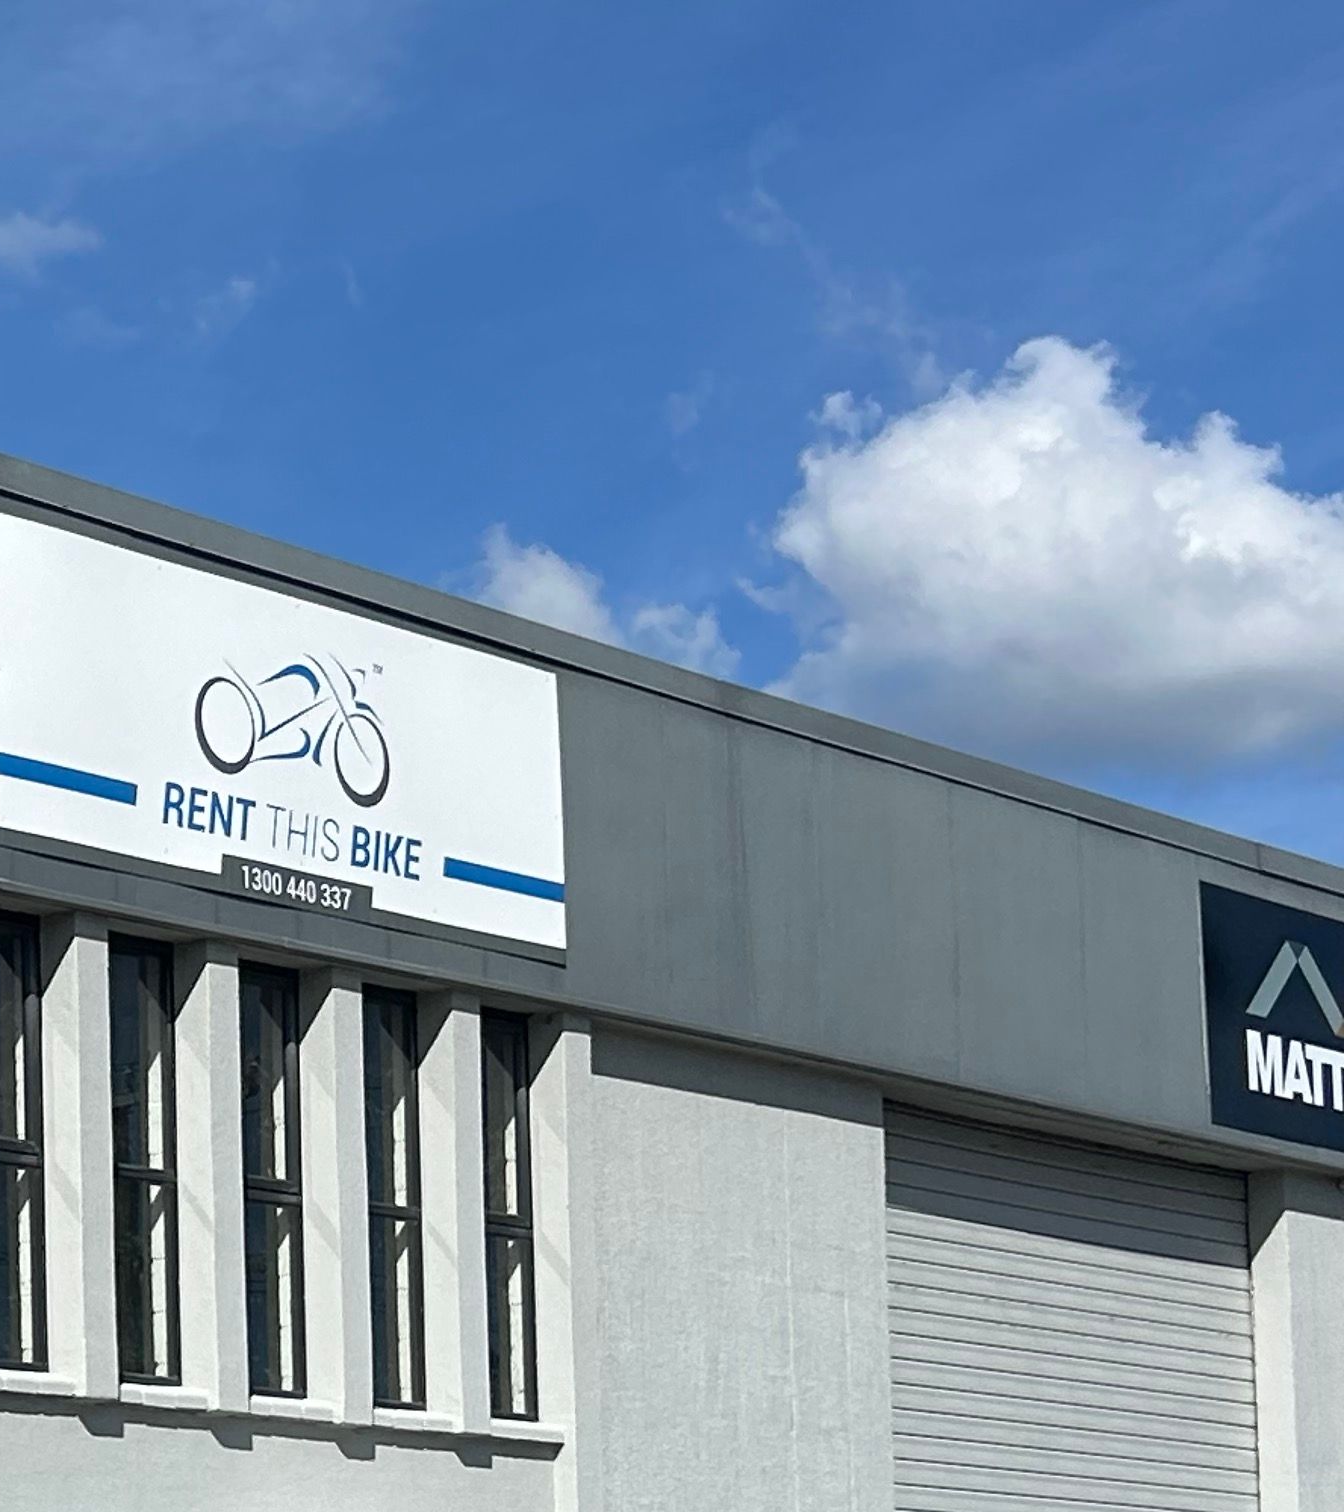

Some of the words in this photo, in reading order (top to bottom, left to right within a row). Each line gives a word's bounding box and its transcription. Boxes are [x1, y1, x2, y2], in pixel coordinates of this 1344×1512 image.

[162, 781, 256, 841] RENT
[266, 803, 340, 862] THIS
[350, 824, 422, 881] BIKE
[241, 864, 283, 895] 1300
[286, 874, 317, 904] 440
[320, 883, 352, 910] 337
